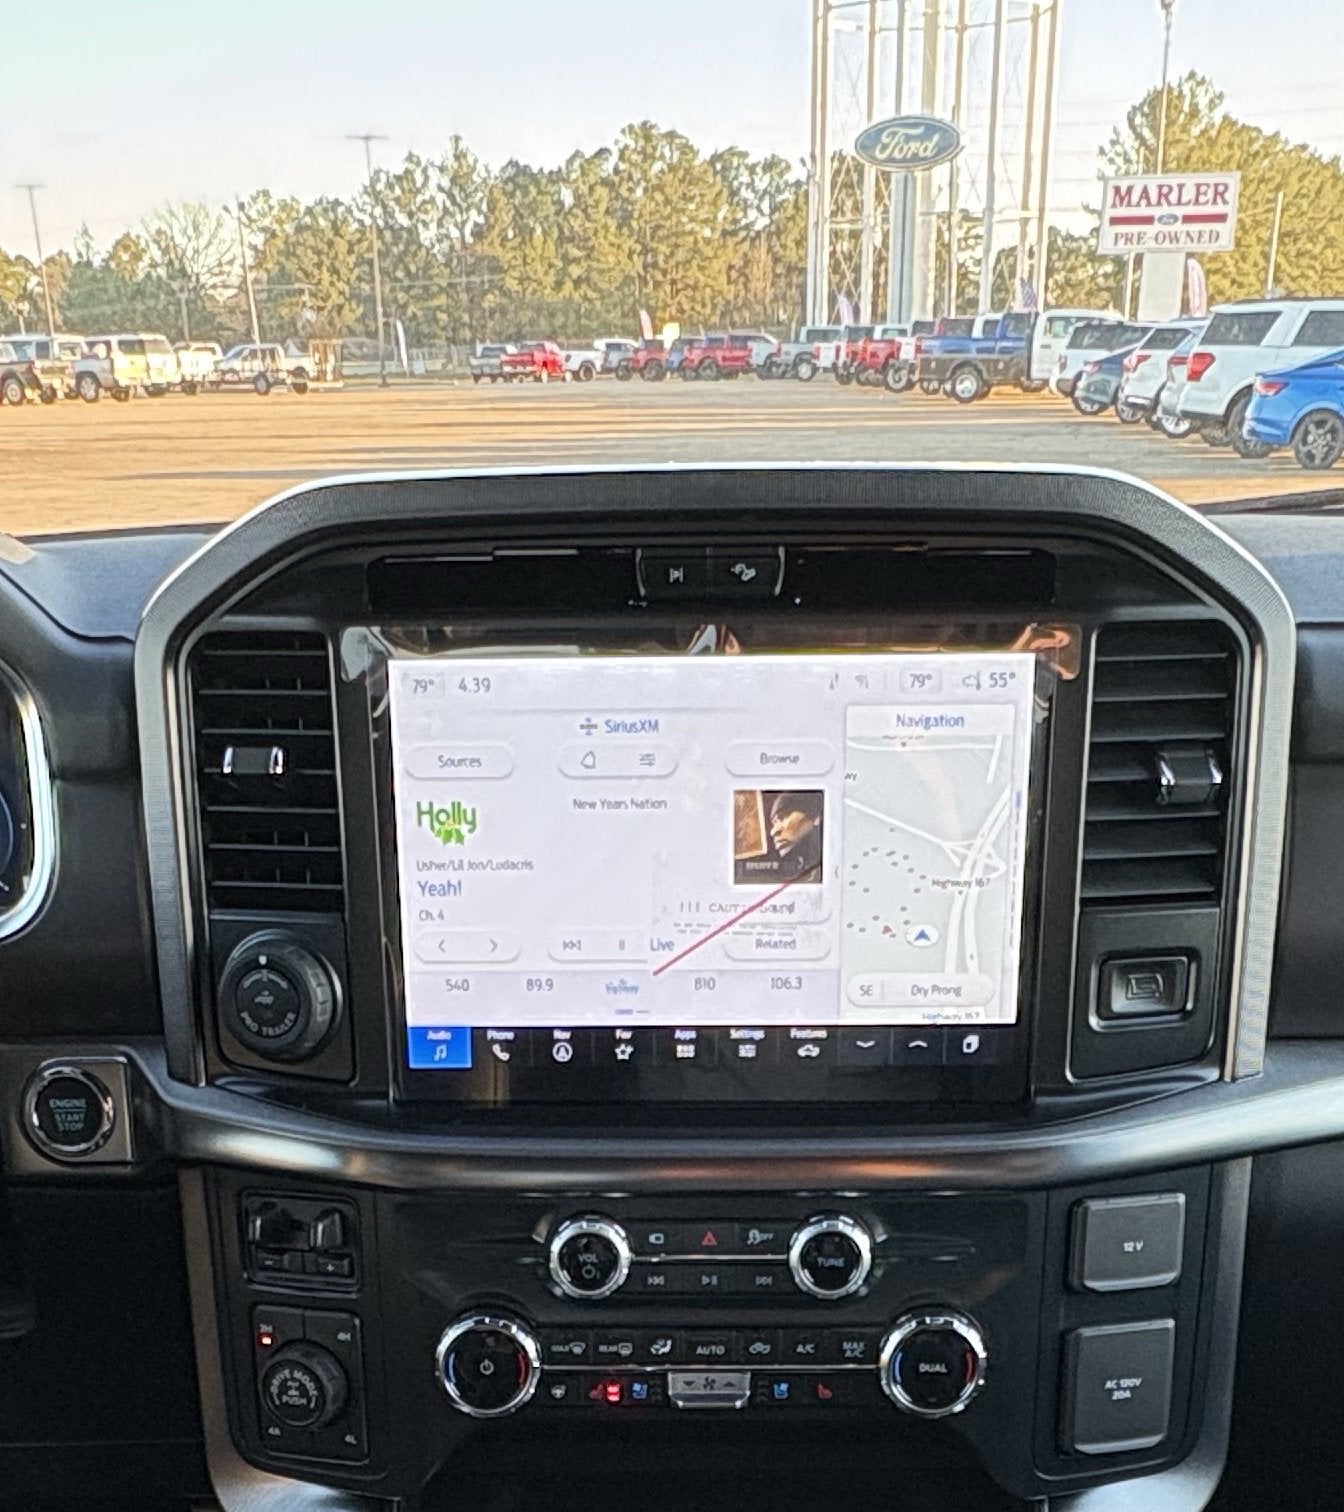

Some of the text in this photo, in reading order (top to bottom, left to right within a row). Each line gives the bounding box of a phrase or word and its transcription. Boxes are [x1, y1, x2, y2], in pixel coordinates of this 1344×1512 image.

[875, 126, 940, 161] Ford
[1109, 182, 1231, 209] MARLER
[1112, 229, 1221, 247] PRE-OWNED
[604, 718, 660, 734] SiriusXM
[895, 713, 965, 729] Navigation
[437, 754, 483, 768] Sources
[572, 798, 668, 810] New Years Nation
[415, 799, 478, 833] Holly
[650, 938, 675, 951] Live
[755, 938, 797, 951] Related
[445, 979, 470, 992] 540
[525, 978, 555, 992] 89.9
[770, 977, 803, 991] 106.3
[859, 985, 874, 997] SE
[577, 1253, 599, 1263] VOL
[695, 1345, 726, 1356] AUTO
[795, 1344, 815, 1354] A/C
[918, 1363, 948, 1373] DUAL
